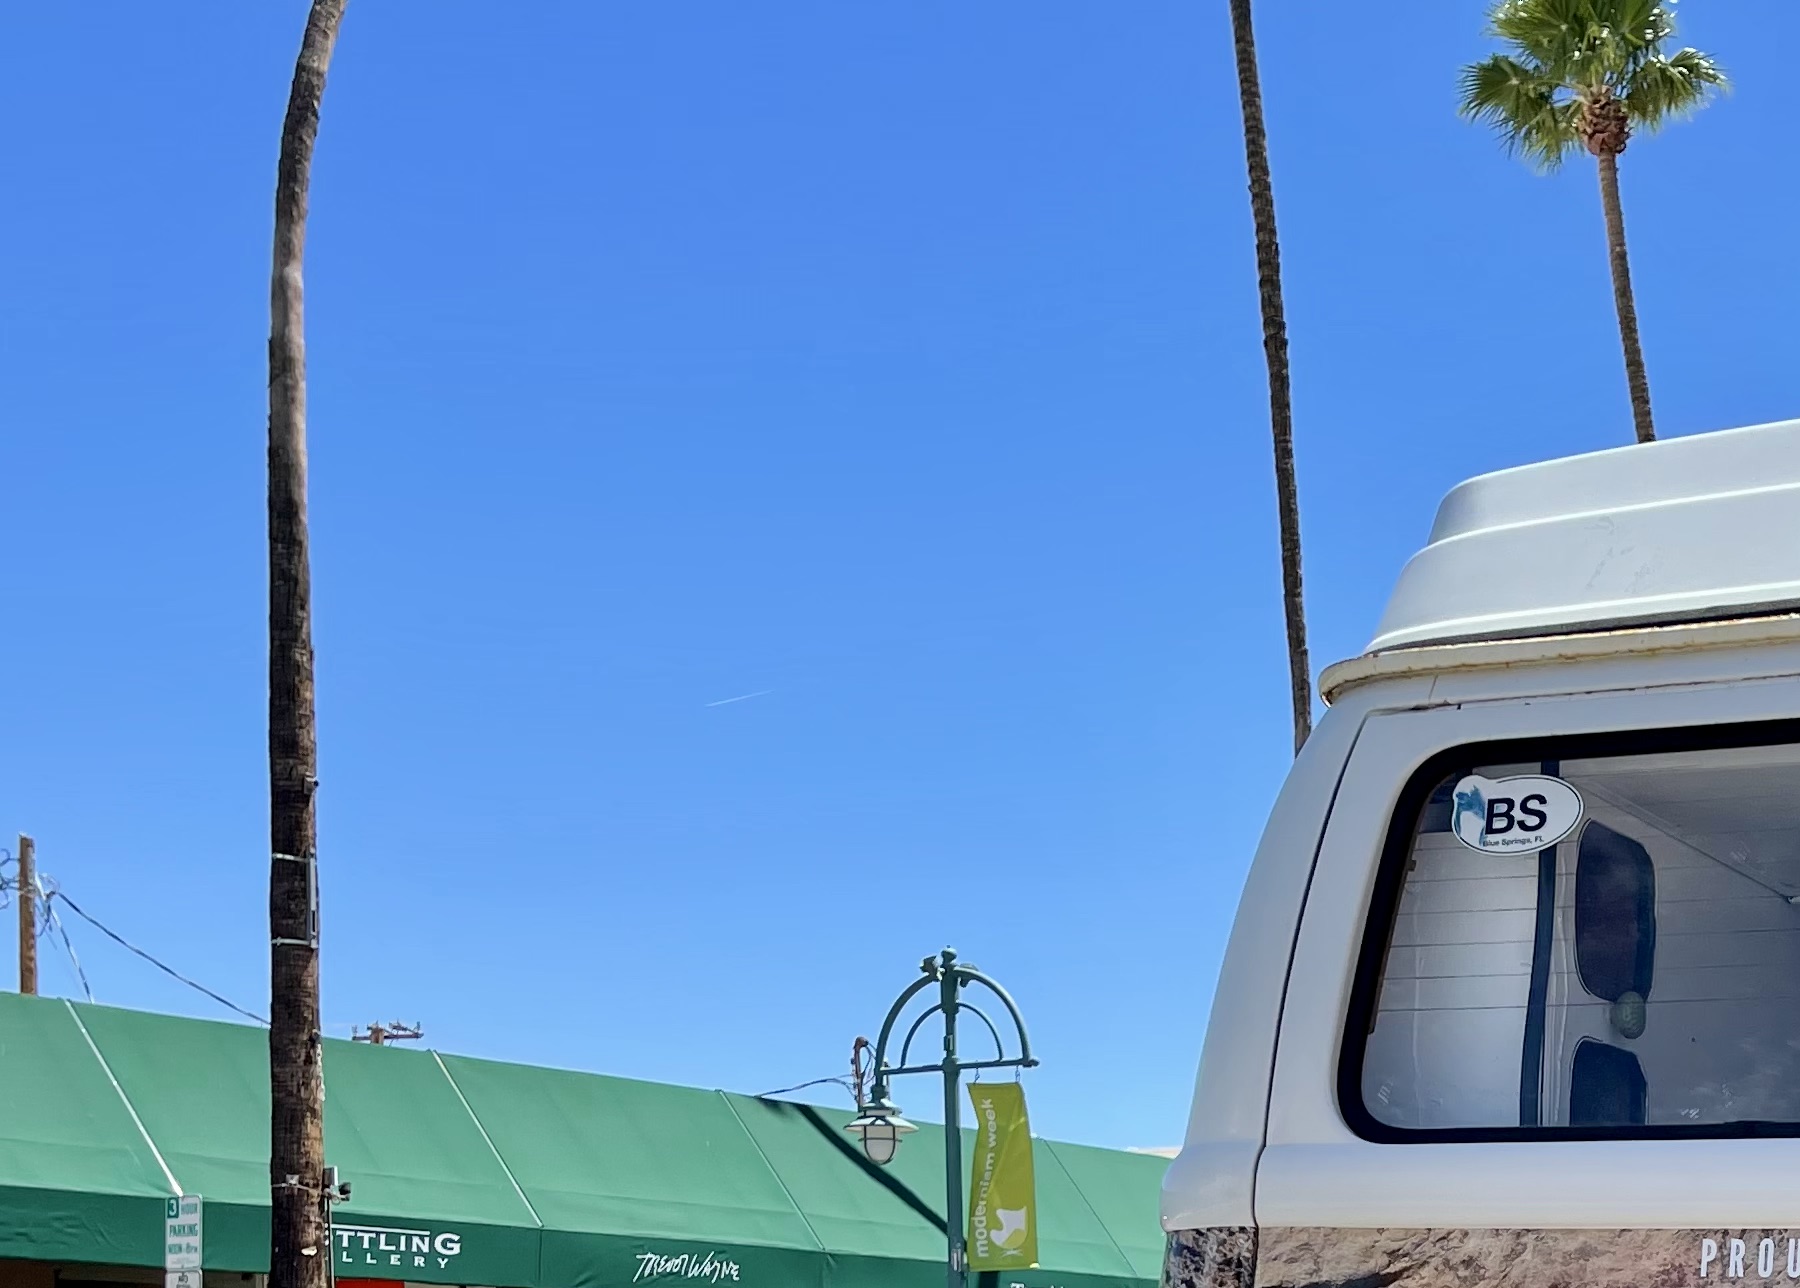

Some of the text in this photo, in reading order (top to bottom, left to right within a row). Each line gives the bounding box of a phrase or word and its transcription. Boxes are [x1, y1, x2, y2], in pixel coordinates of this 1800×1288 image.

[1485, 794, 1547, 835] BS
[971, 1098, 997, 1258] modernism week
[341, 1251, 449, 1269] LLERY
